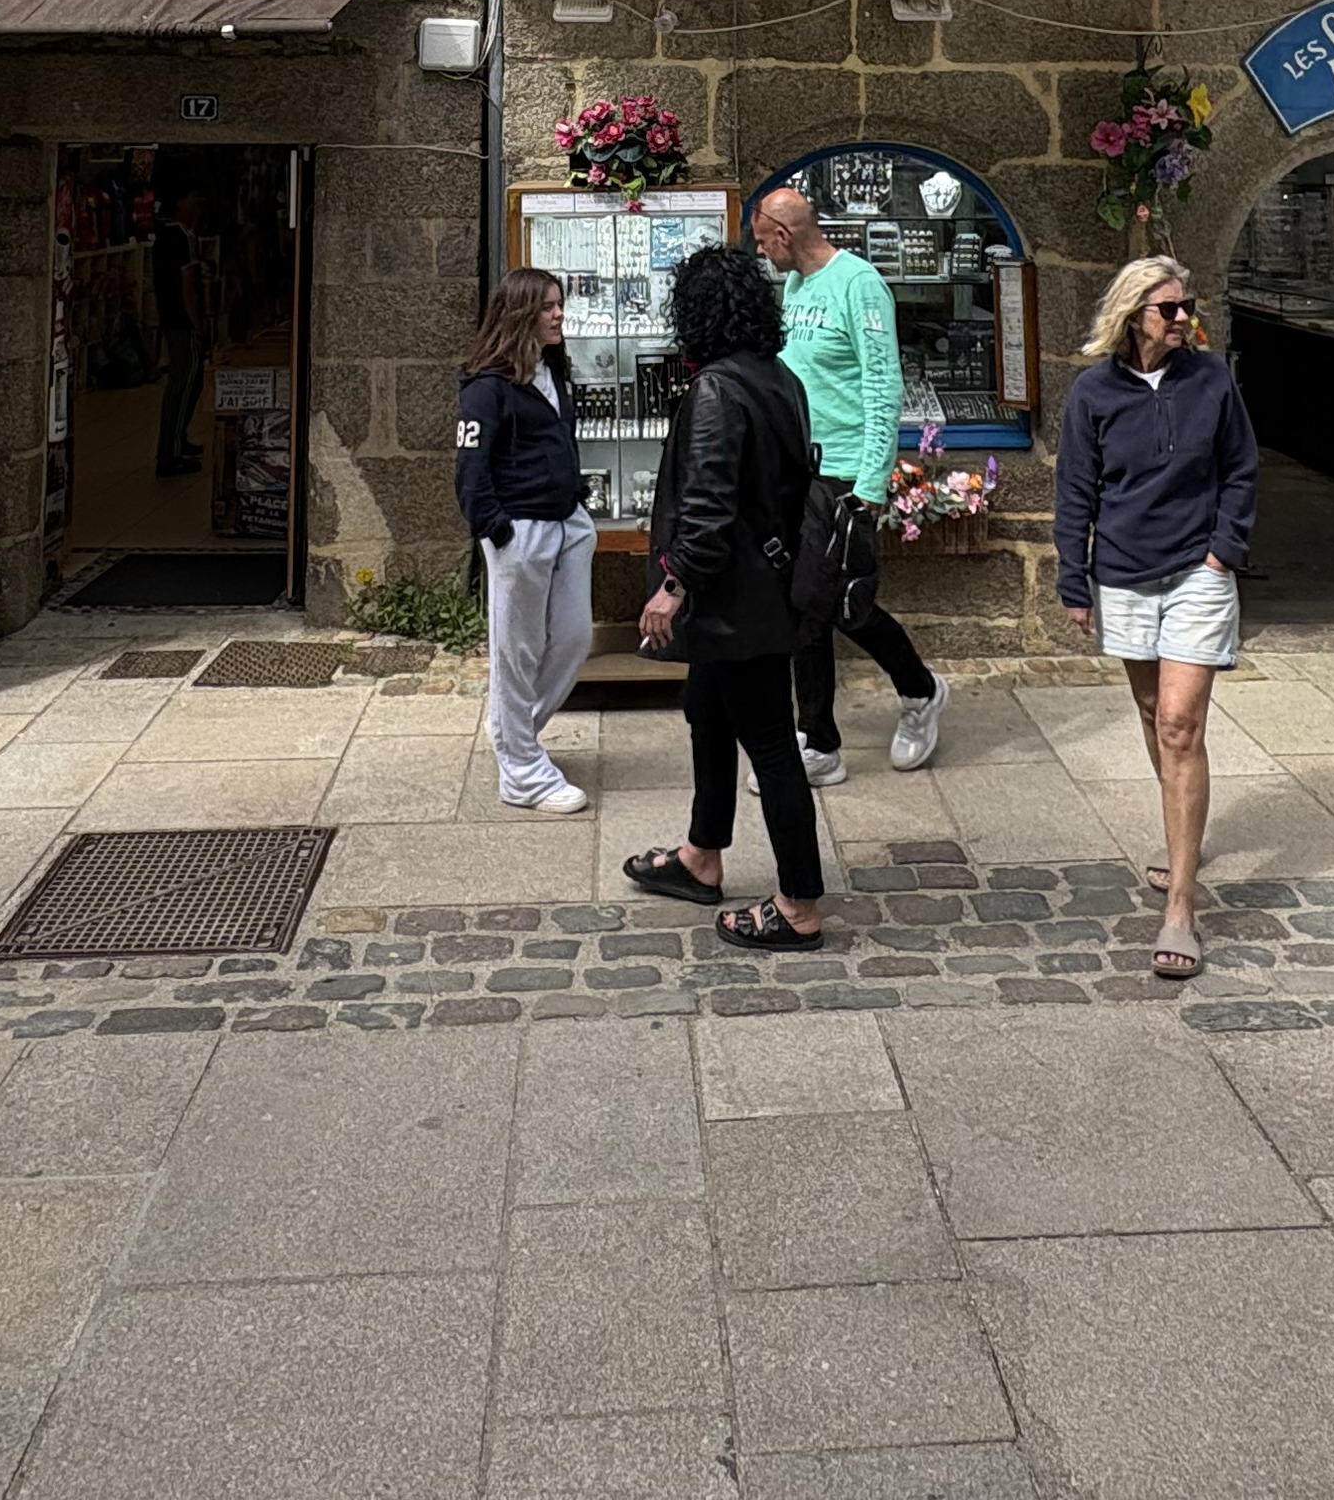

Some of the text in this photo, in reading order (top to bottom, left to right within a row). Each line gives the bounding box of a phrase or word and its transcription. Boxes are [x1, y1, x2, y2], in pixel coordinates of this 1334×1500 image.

[1282, 39, 1328, 80] LES
[188, 99, 211, 116] 17
[456, 420, 481, 448] 82
